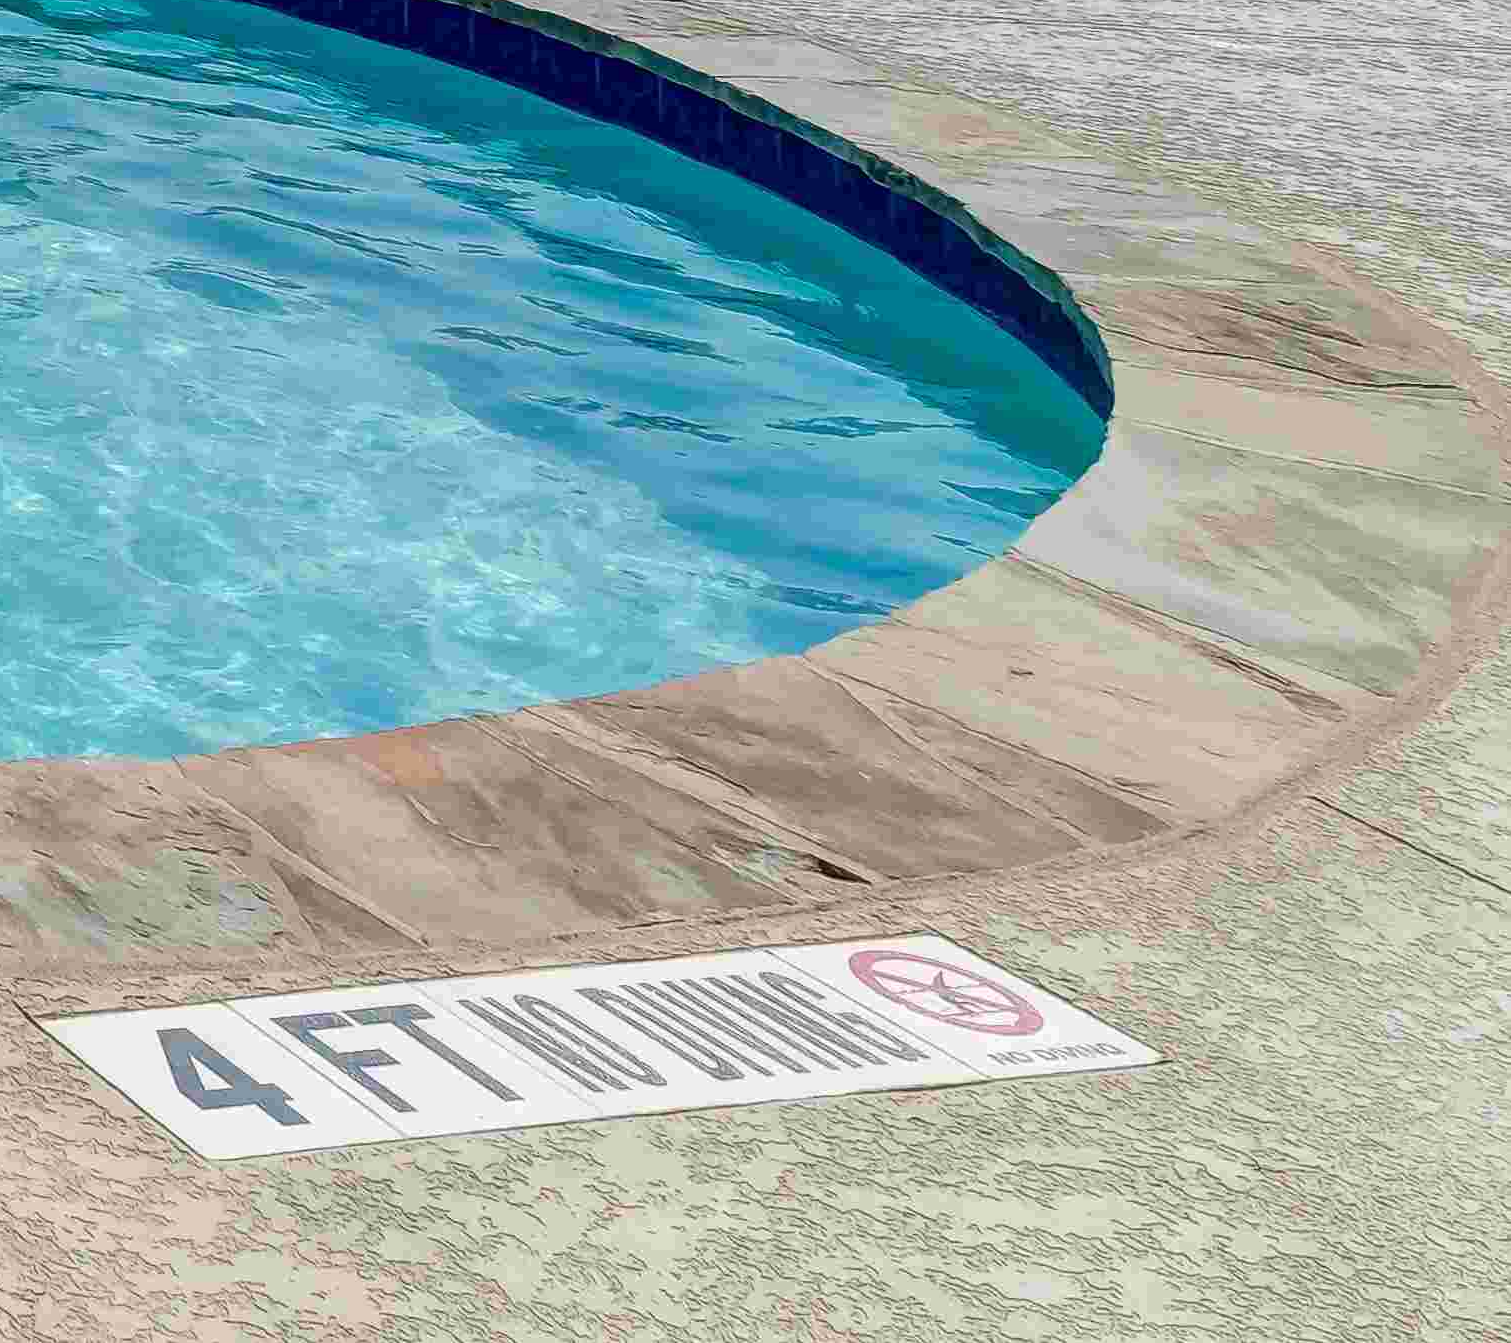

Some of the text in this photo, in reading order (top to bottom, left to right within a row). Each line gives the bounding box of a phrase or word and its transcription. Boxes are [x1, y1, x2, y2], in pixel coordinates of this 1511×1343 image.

[155, 971, 932, 1126] 4 FT NO DIVING
[987, 1042, 1128, 1066] NO DIVING
